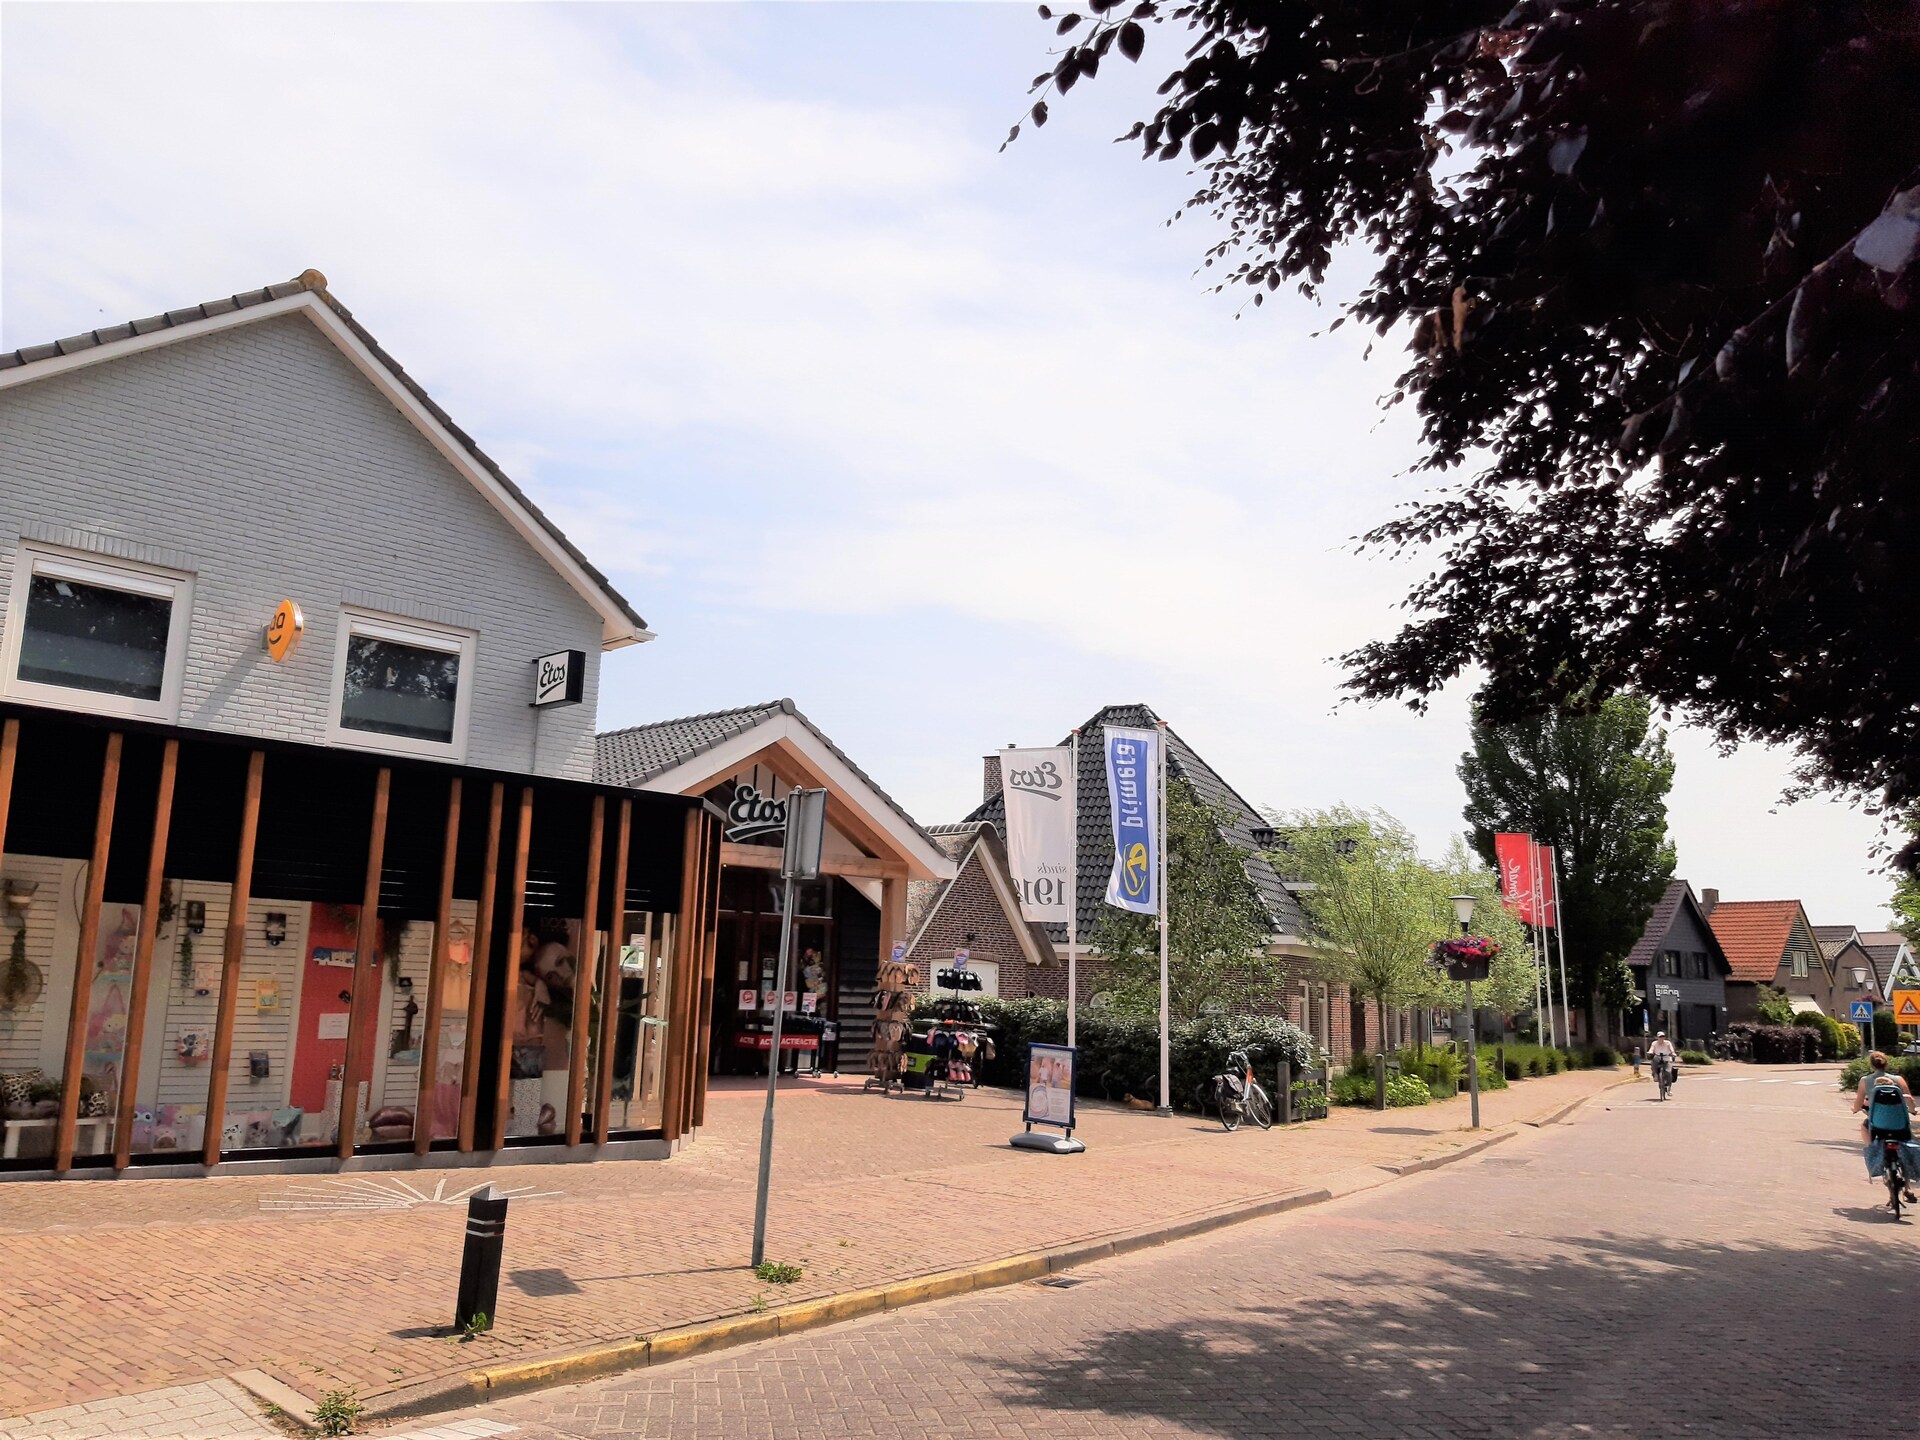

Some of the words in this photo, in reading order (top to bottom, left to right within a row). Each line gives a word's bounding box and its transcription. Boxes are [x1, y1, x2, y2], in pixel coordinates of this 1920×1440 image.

[539, 661, 566, 688] Etos
[729, 784, 787, 824] Etos
[759, 1037, 773, 1046] ACT
